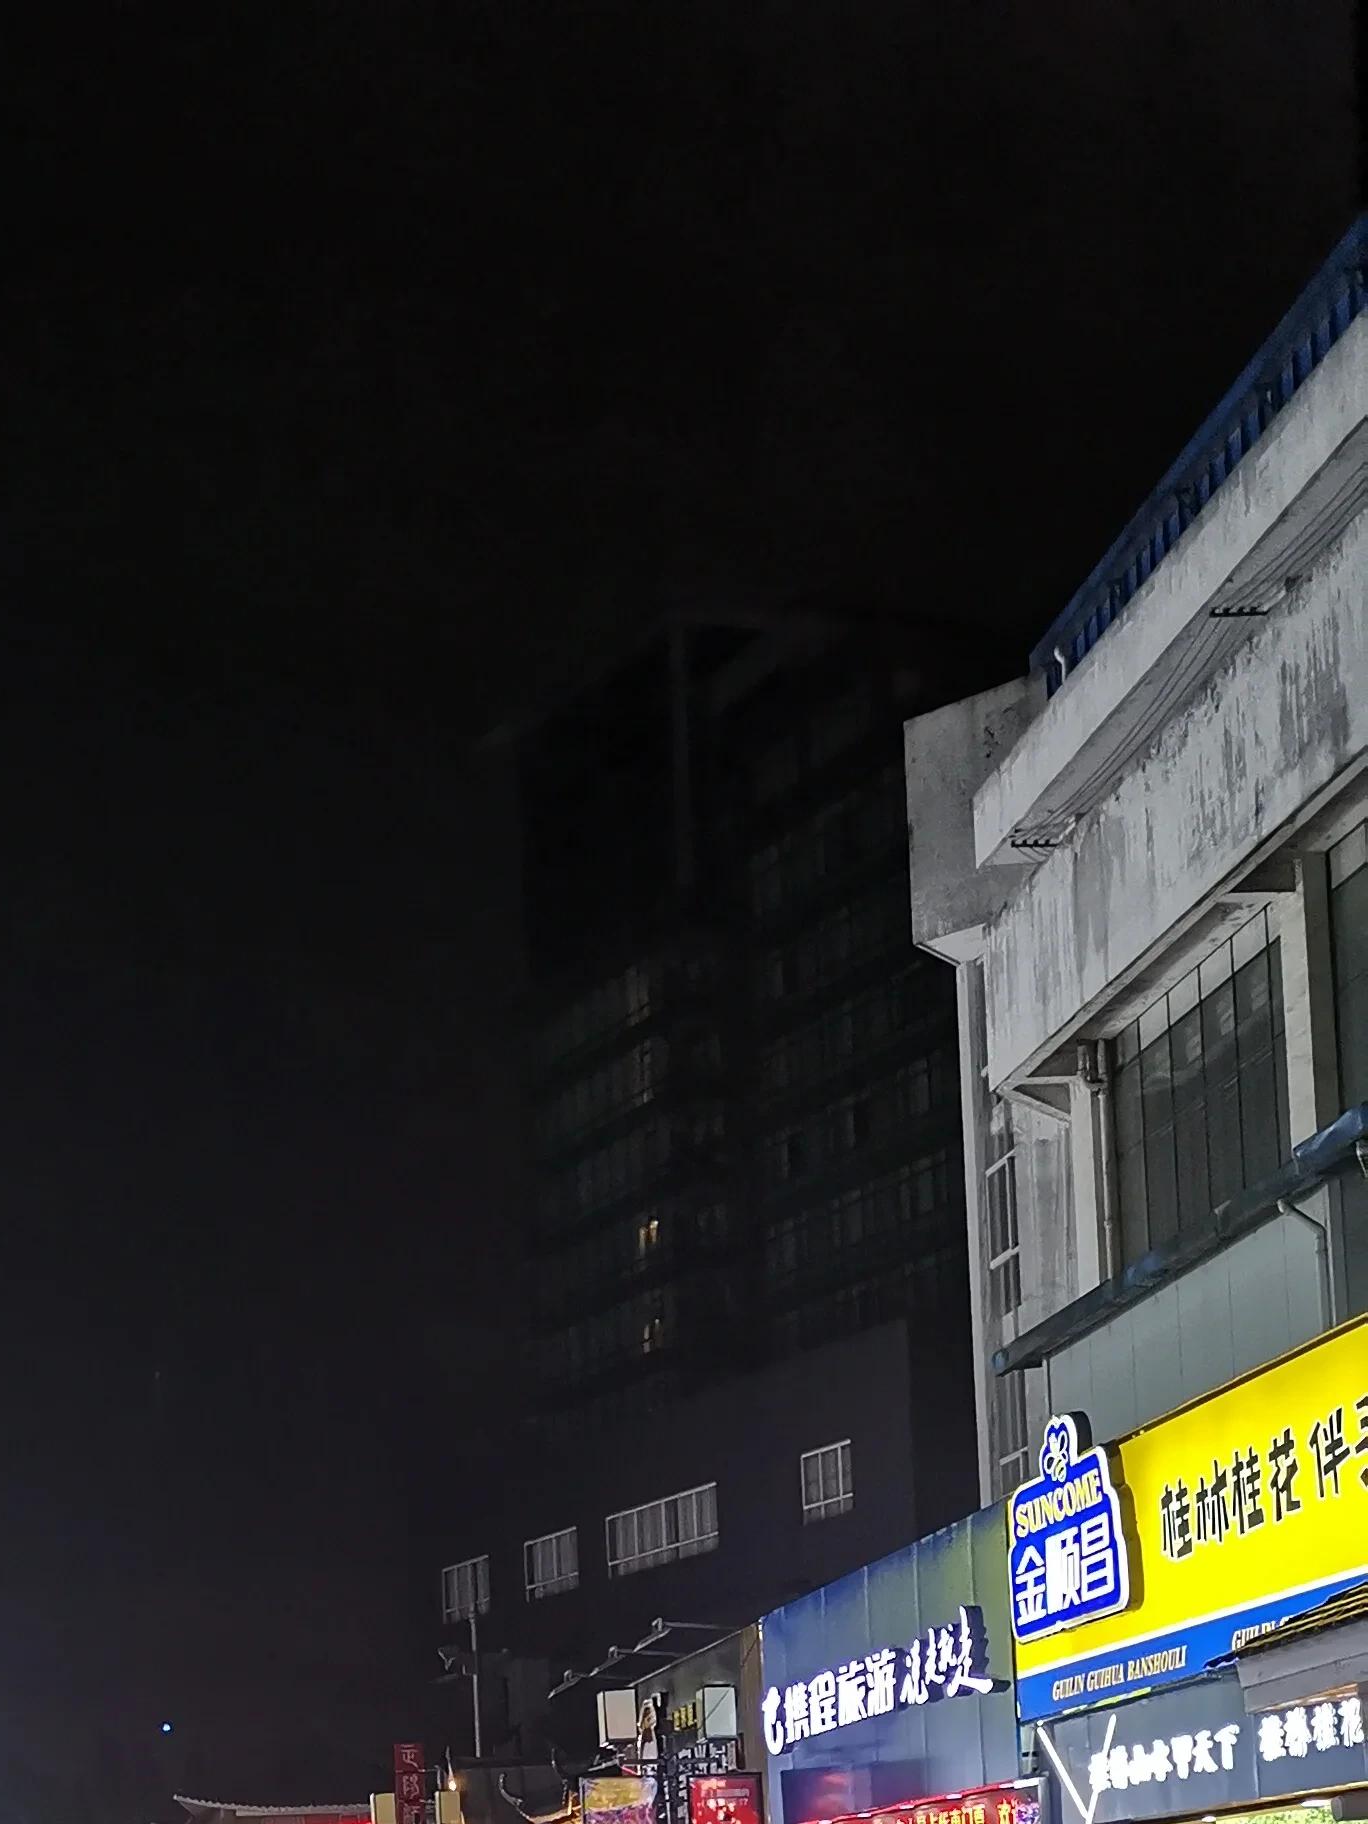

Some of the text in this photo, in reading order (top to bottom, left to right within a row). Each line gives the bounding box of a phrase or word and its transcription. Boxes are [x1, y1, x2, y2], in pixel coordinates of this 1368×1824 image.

[1015, 1467, 1103, 1538] SUNCOME
[783, 1648, 897, 1744] 携程旅游
[1052, 1645, 1188, 1701] GUILIN GUIHUA BANSHOULI
